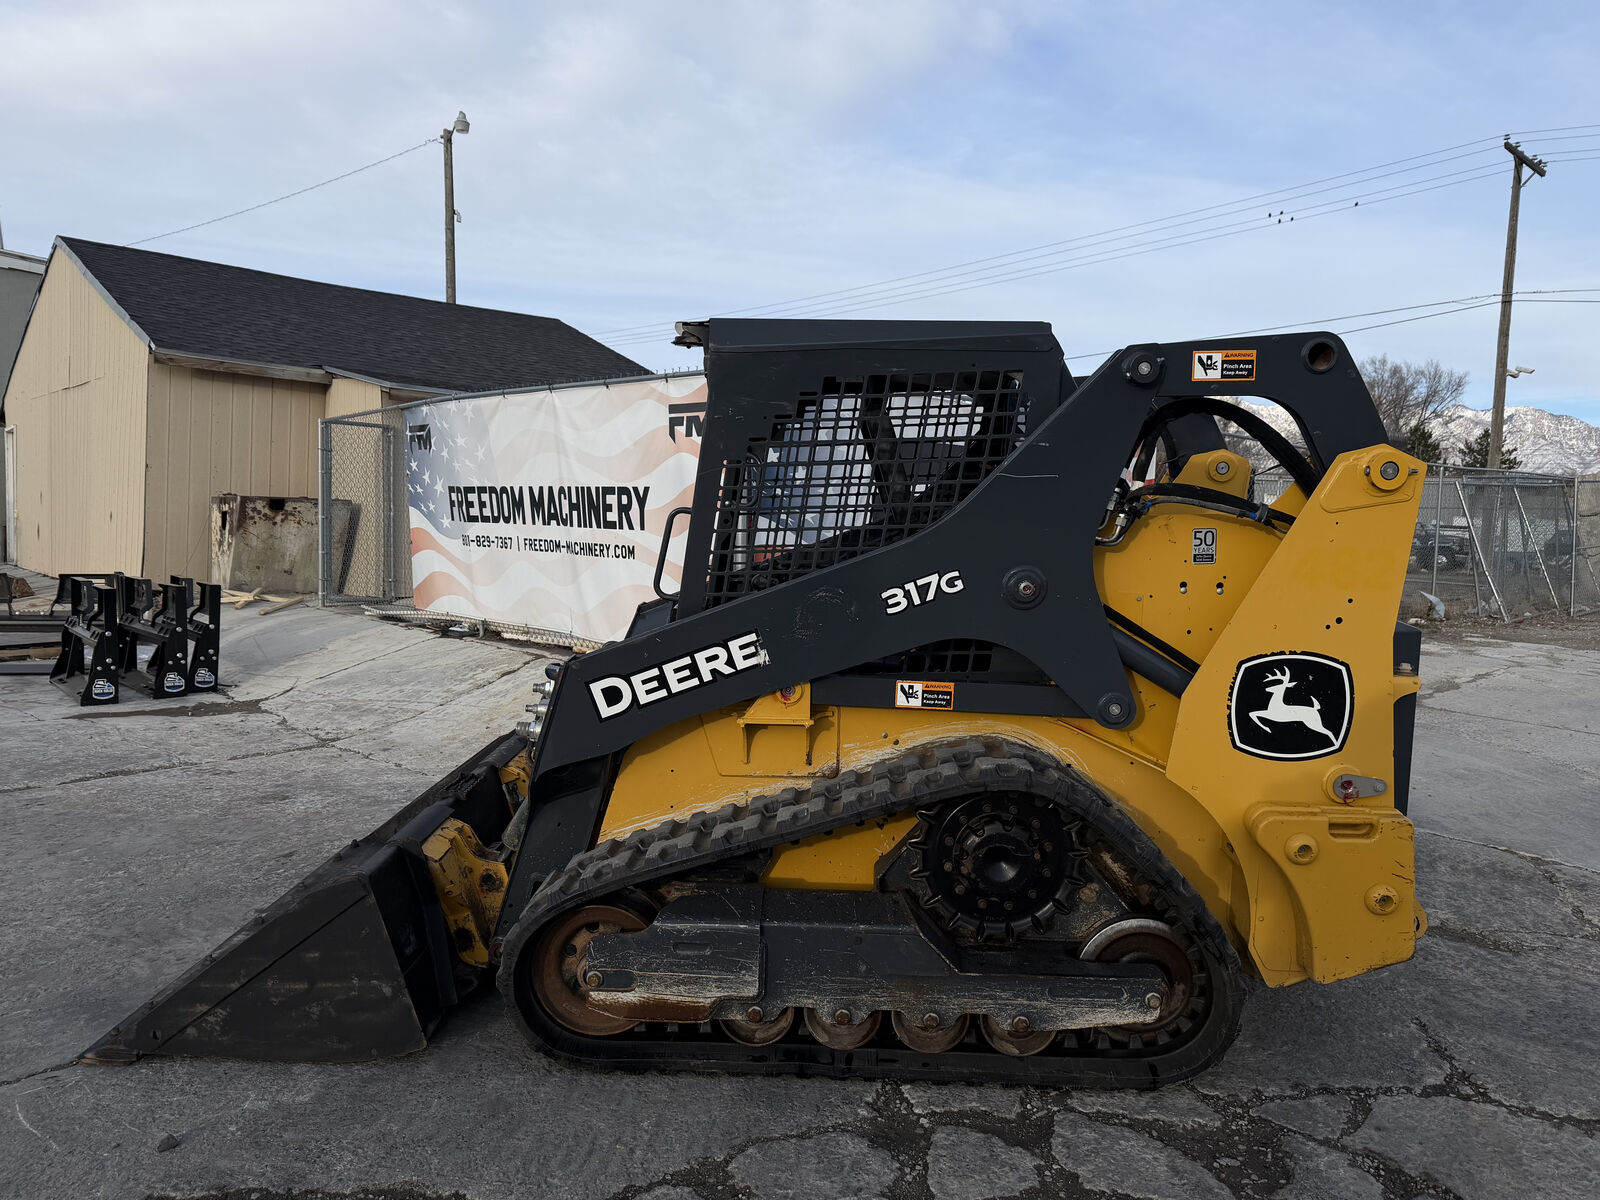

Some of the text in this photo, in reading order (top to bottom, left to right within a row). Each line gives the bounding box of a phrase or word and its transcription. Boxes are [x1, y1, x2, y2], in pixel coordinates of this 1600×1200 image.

[448, 485, 650, 531] FREEDOM MACHINERY
[523, 538, 636, 560] FREEDOM-MACHINERY.COM
[1193, 530, 1215, 546] 50
[881, 570, 965, 615] 317G
[588, 632, 770, 719] DEERE
